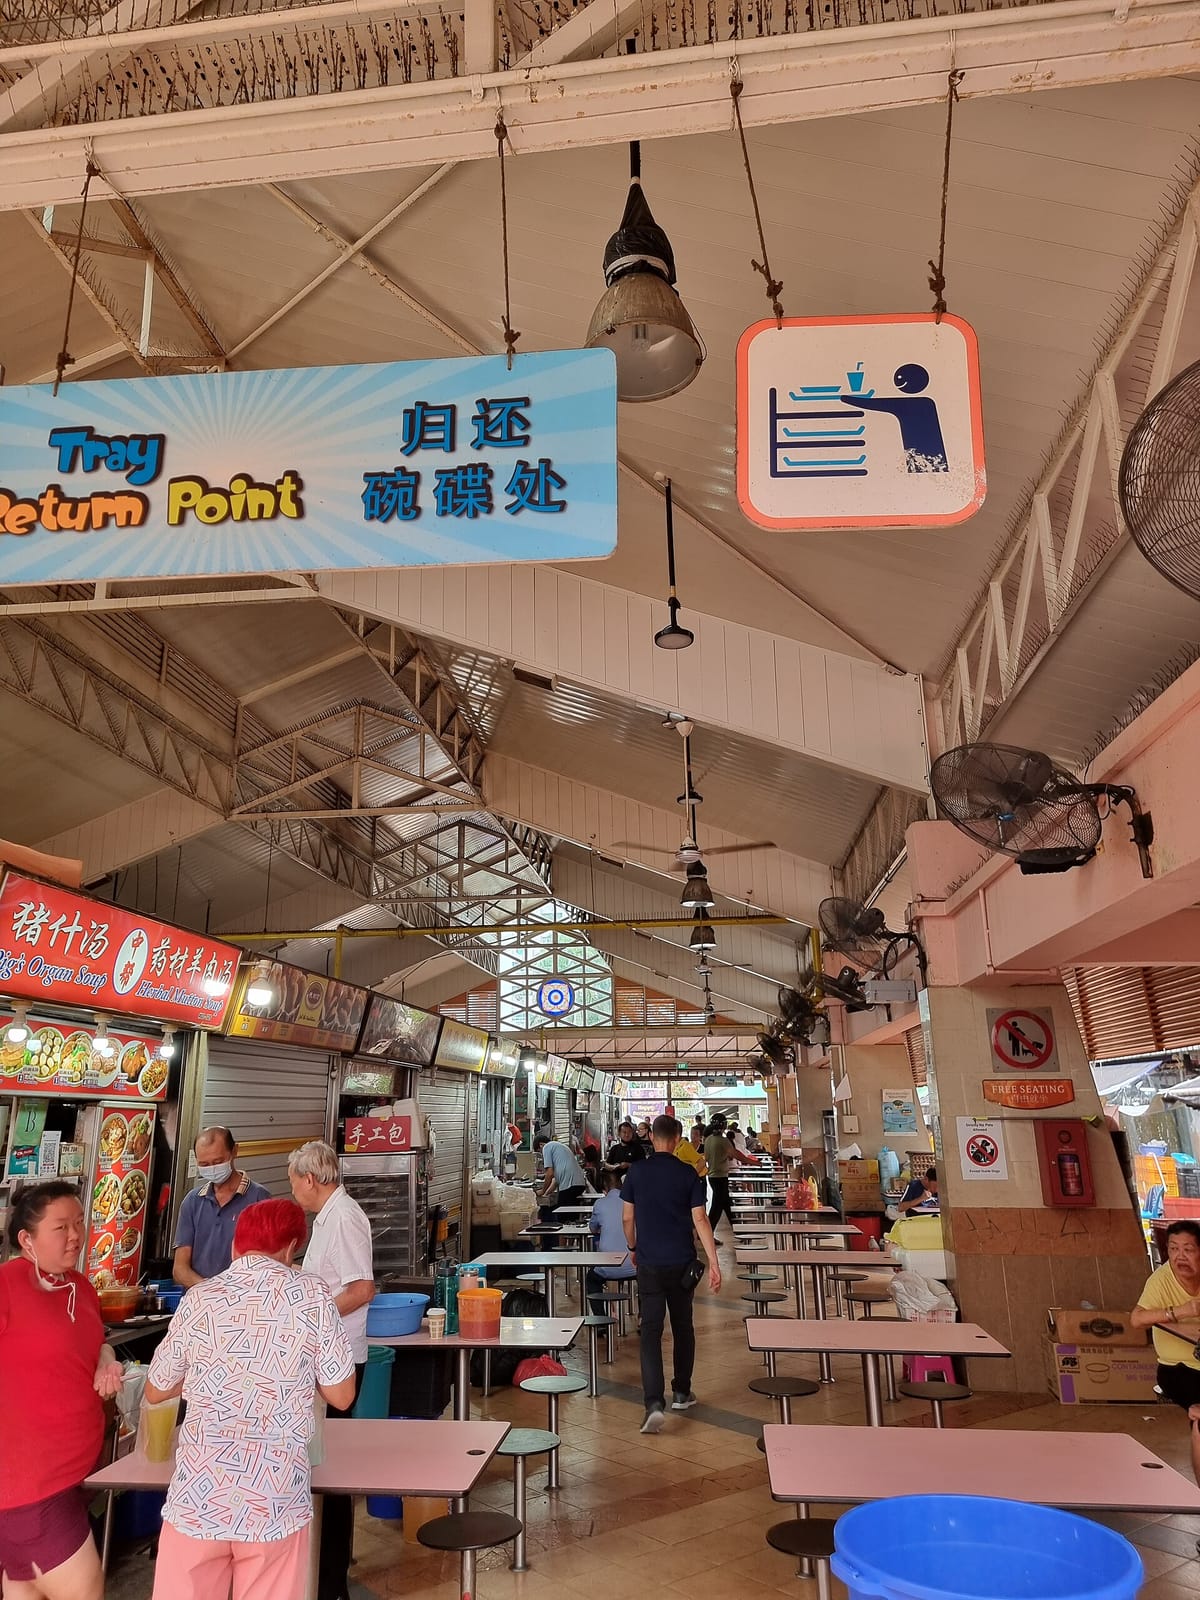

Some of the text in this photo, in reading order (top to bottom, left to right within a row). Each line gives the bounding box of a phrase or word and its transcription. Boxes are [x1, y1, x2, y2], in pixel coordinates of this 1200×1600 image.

[400, 397, 530, 456] 归还
[48, 426, 165, 485] Tray
[167, 470, 304, 526] Point
[361, 458, 567, 523] 碗碟处
[12, 901, 109, 960] 猪什汤
[27, 955, 74, 987] Organ
[74, 965, 108, 994] Soup
[139, 980, 223, 1017] Herbal Mutton Soup
[992, 1085, 1065, 1094] FREE SEATING
[24, 1110, 37, 1133] B
[349, 1122, 406, 1148] 手工包
